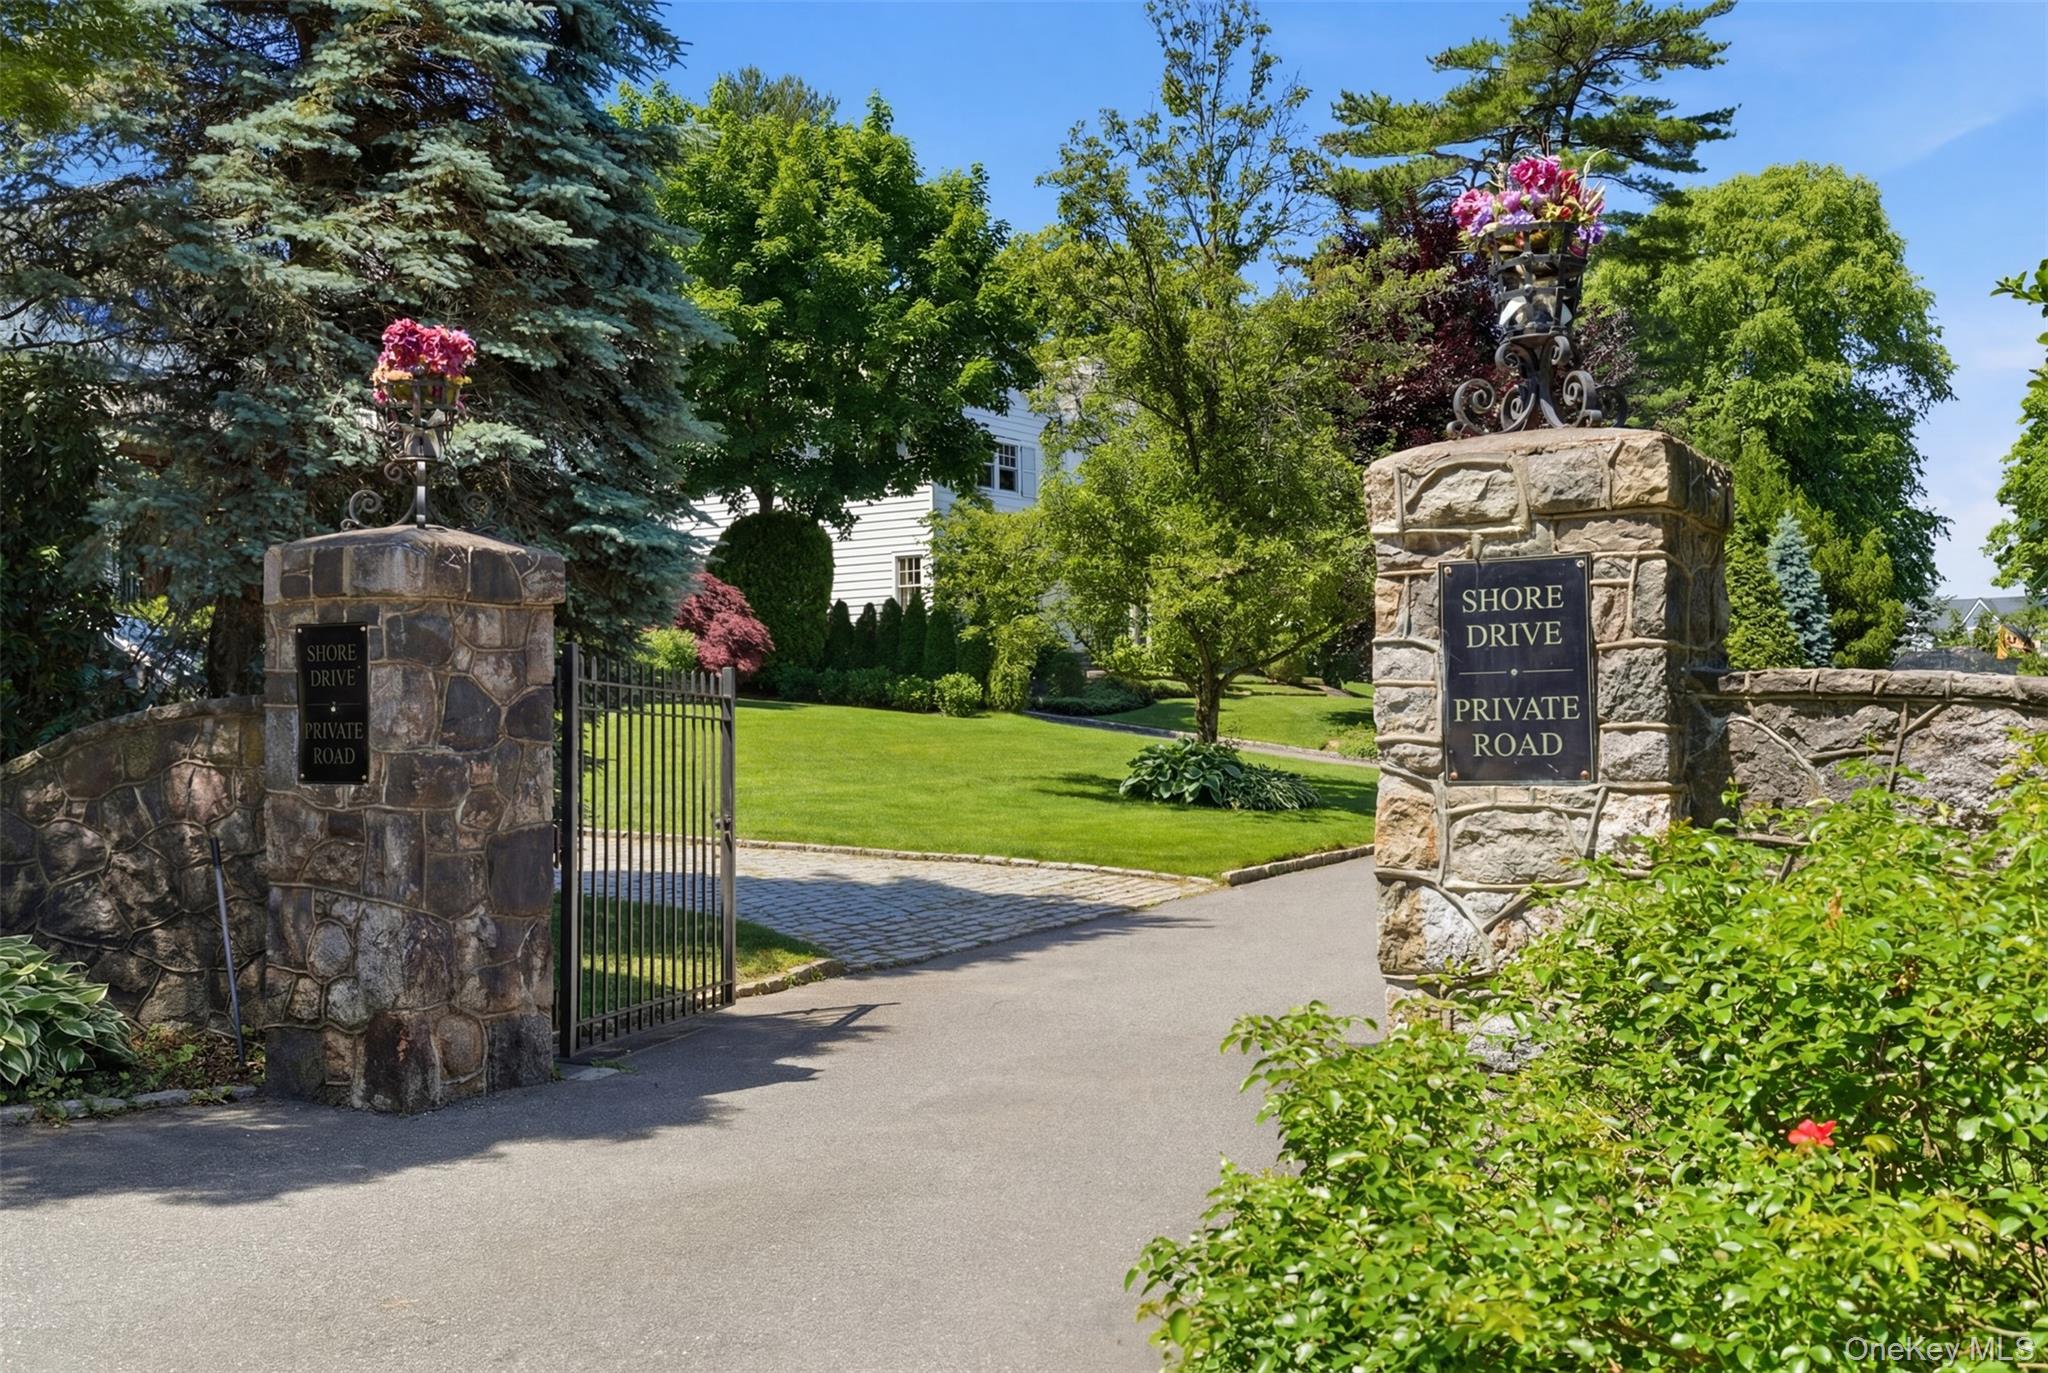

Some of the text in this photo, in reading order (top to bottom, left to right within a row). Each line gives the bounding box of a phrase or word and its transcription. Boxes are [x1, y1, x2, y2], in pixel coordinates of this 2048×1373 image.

[1462, 585, 1565, 613] SHORE
[1466, 621, 1563, 648] DRIVE
[307, 644, 357, 662] SHORE
[310, 669, 356, 687] DRIVE
[1453, 695, 1581, 722] PRIVATE
[305, 722, 364, 739] PRIVATE
[313, 747, 355, 765] ROAD
[1472, 732, 1563, 758] ROAD
